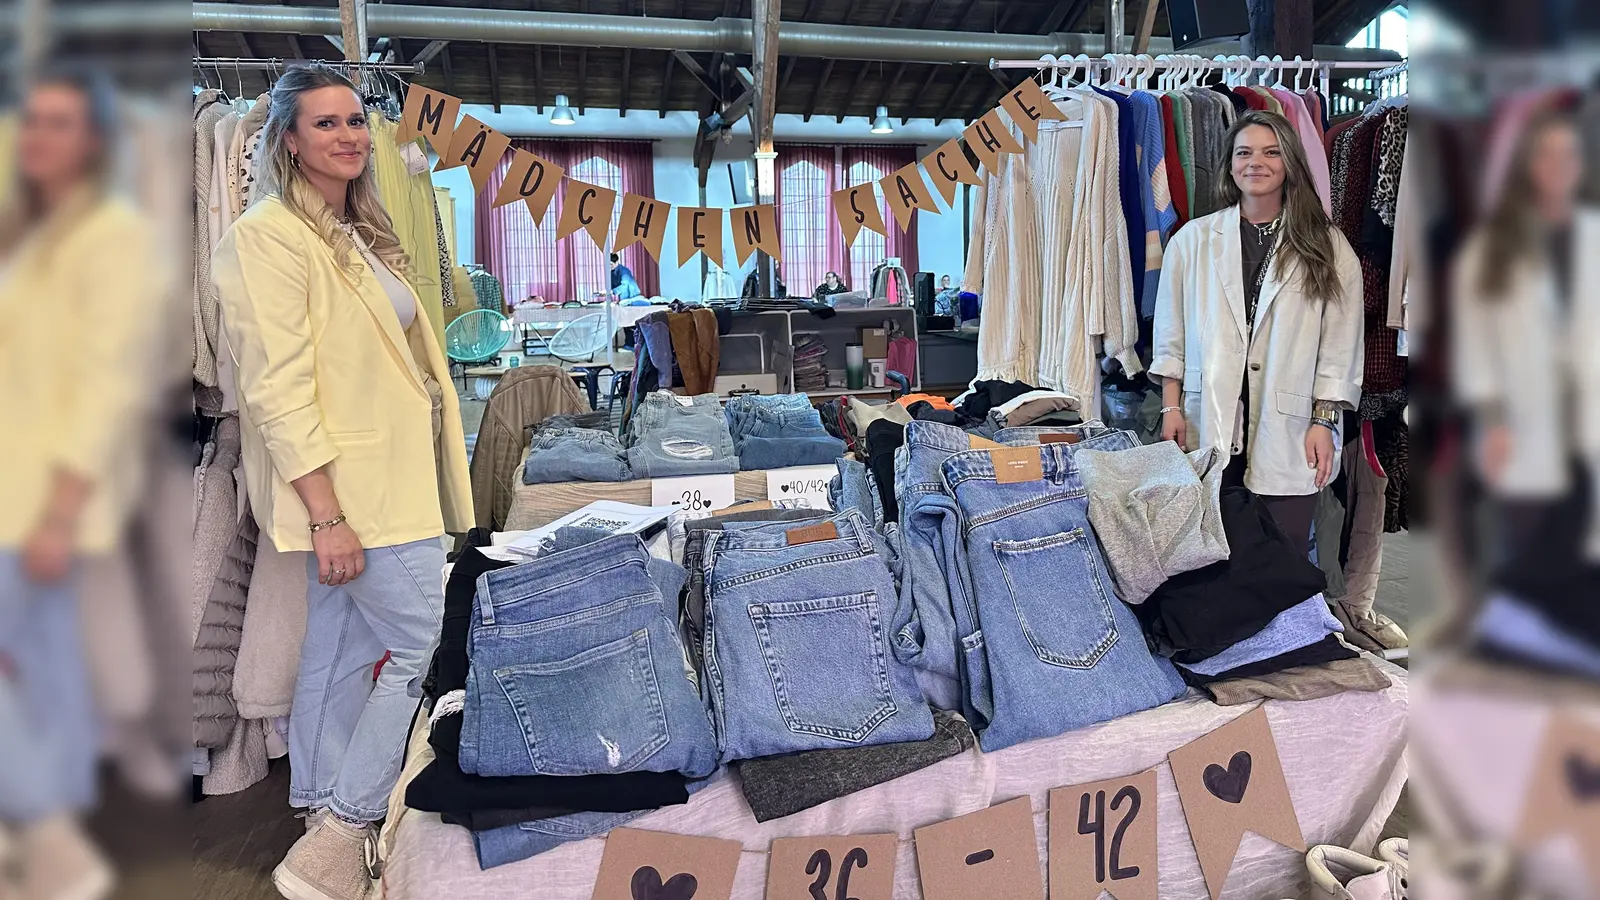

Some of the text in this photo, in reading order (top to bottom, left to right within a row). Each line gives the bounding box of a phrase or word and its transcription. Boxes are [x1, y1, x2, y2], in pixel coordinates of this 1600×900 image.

[416, 89, 1042, 248] MÄDCHEN SACHE
[681, 489, 703, 512] 38
[789, 479, 825, 495] 40/42
[1077, 785, 1142, 883] 42
